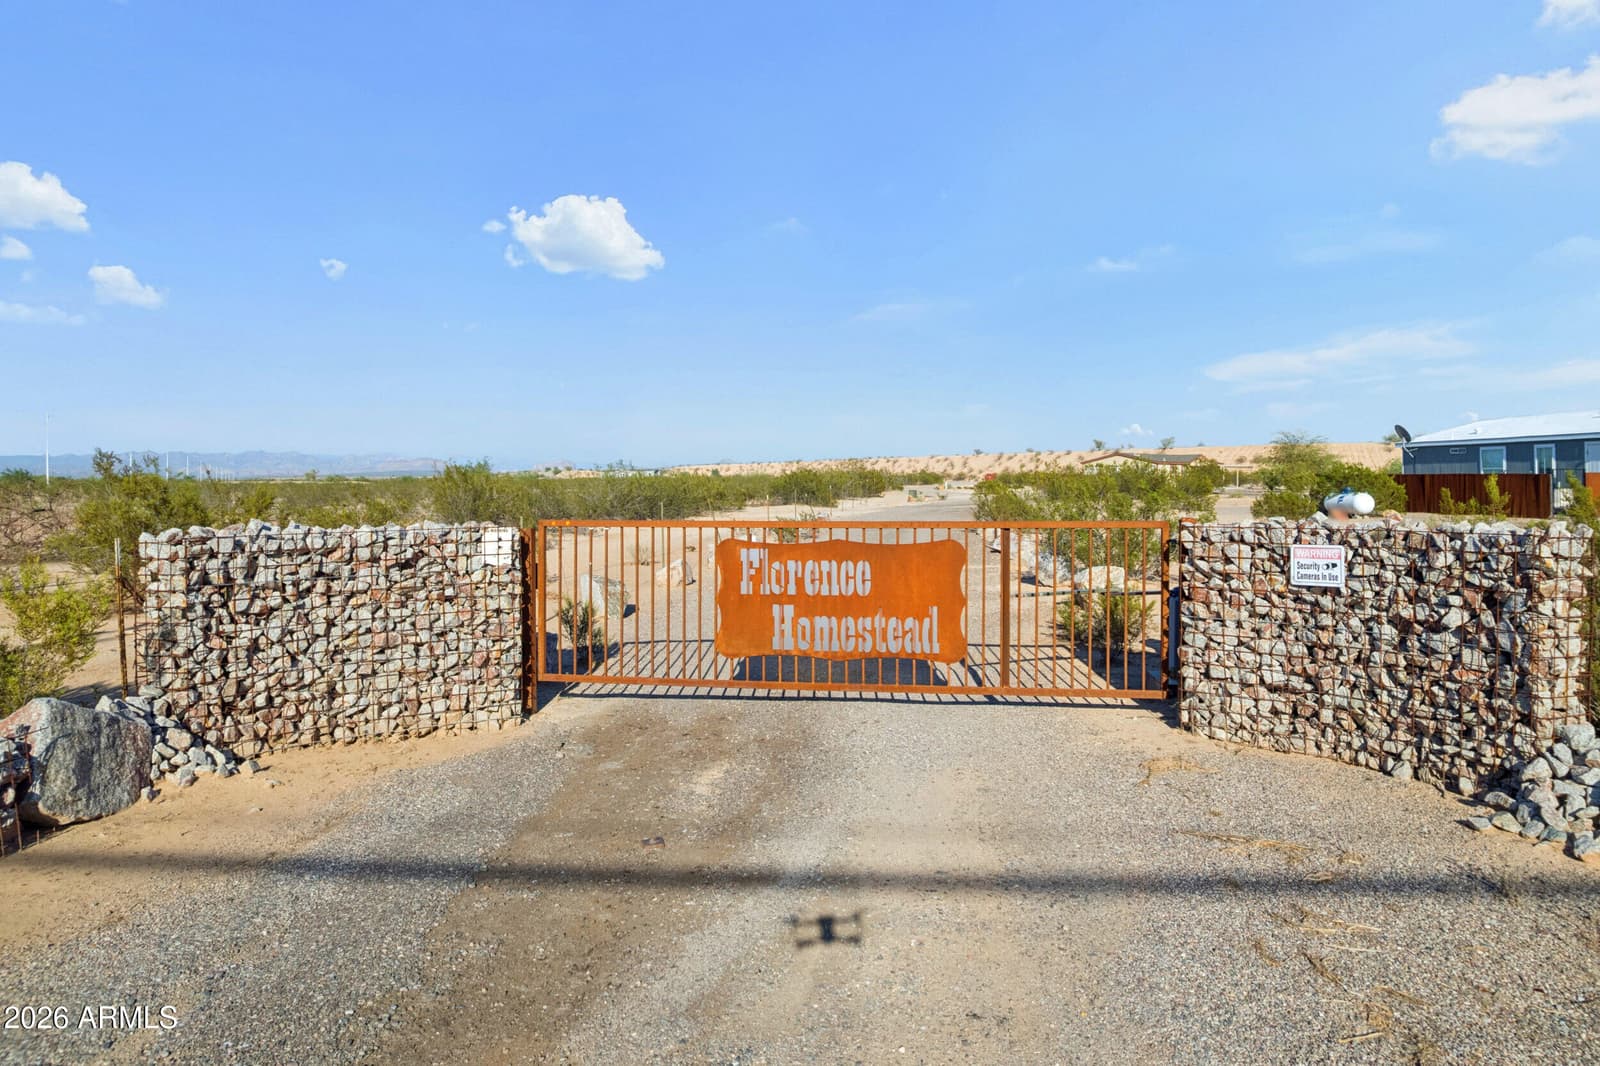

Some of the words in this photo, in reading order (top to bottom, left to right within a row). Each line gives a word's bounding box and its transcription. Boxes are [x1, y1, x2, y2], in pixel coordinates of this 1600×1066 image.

[1295, 549, 1339, 559] WARNING
[740, 548, 872, 596] Florence
[1296, 561, 1320, 572] Security
[1296, 571, 1320, 580] Cameras
[1328, 572, 1339, 581] Use
[772, 604, 940, 654] Homestead
